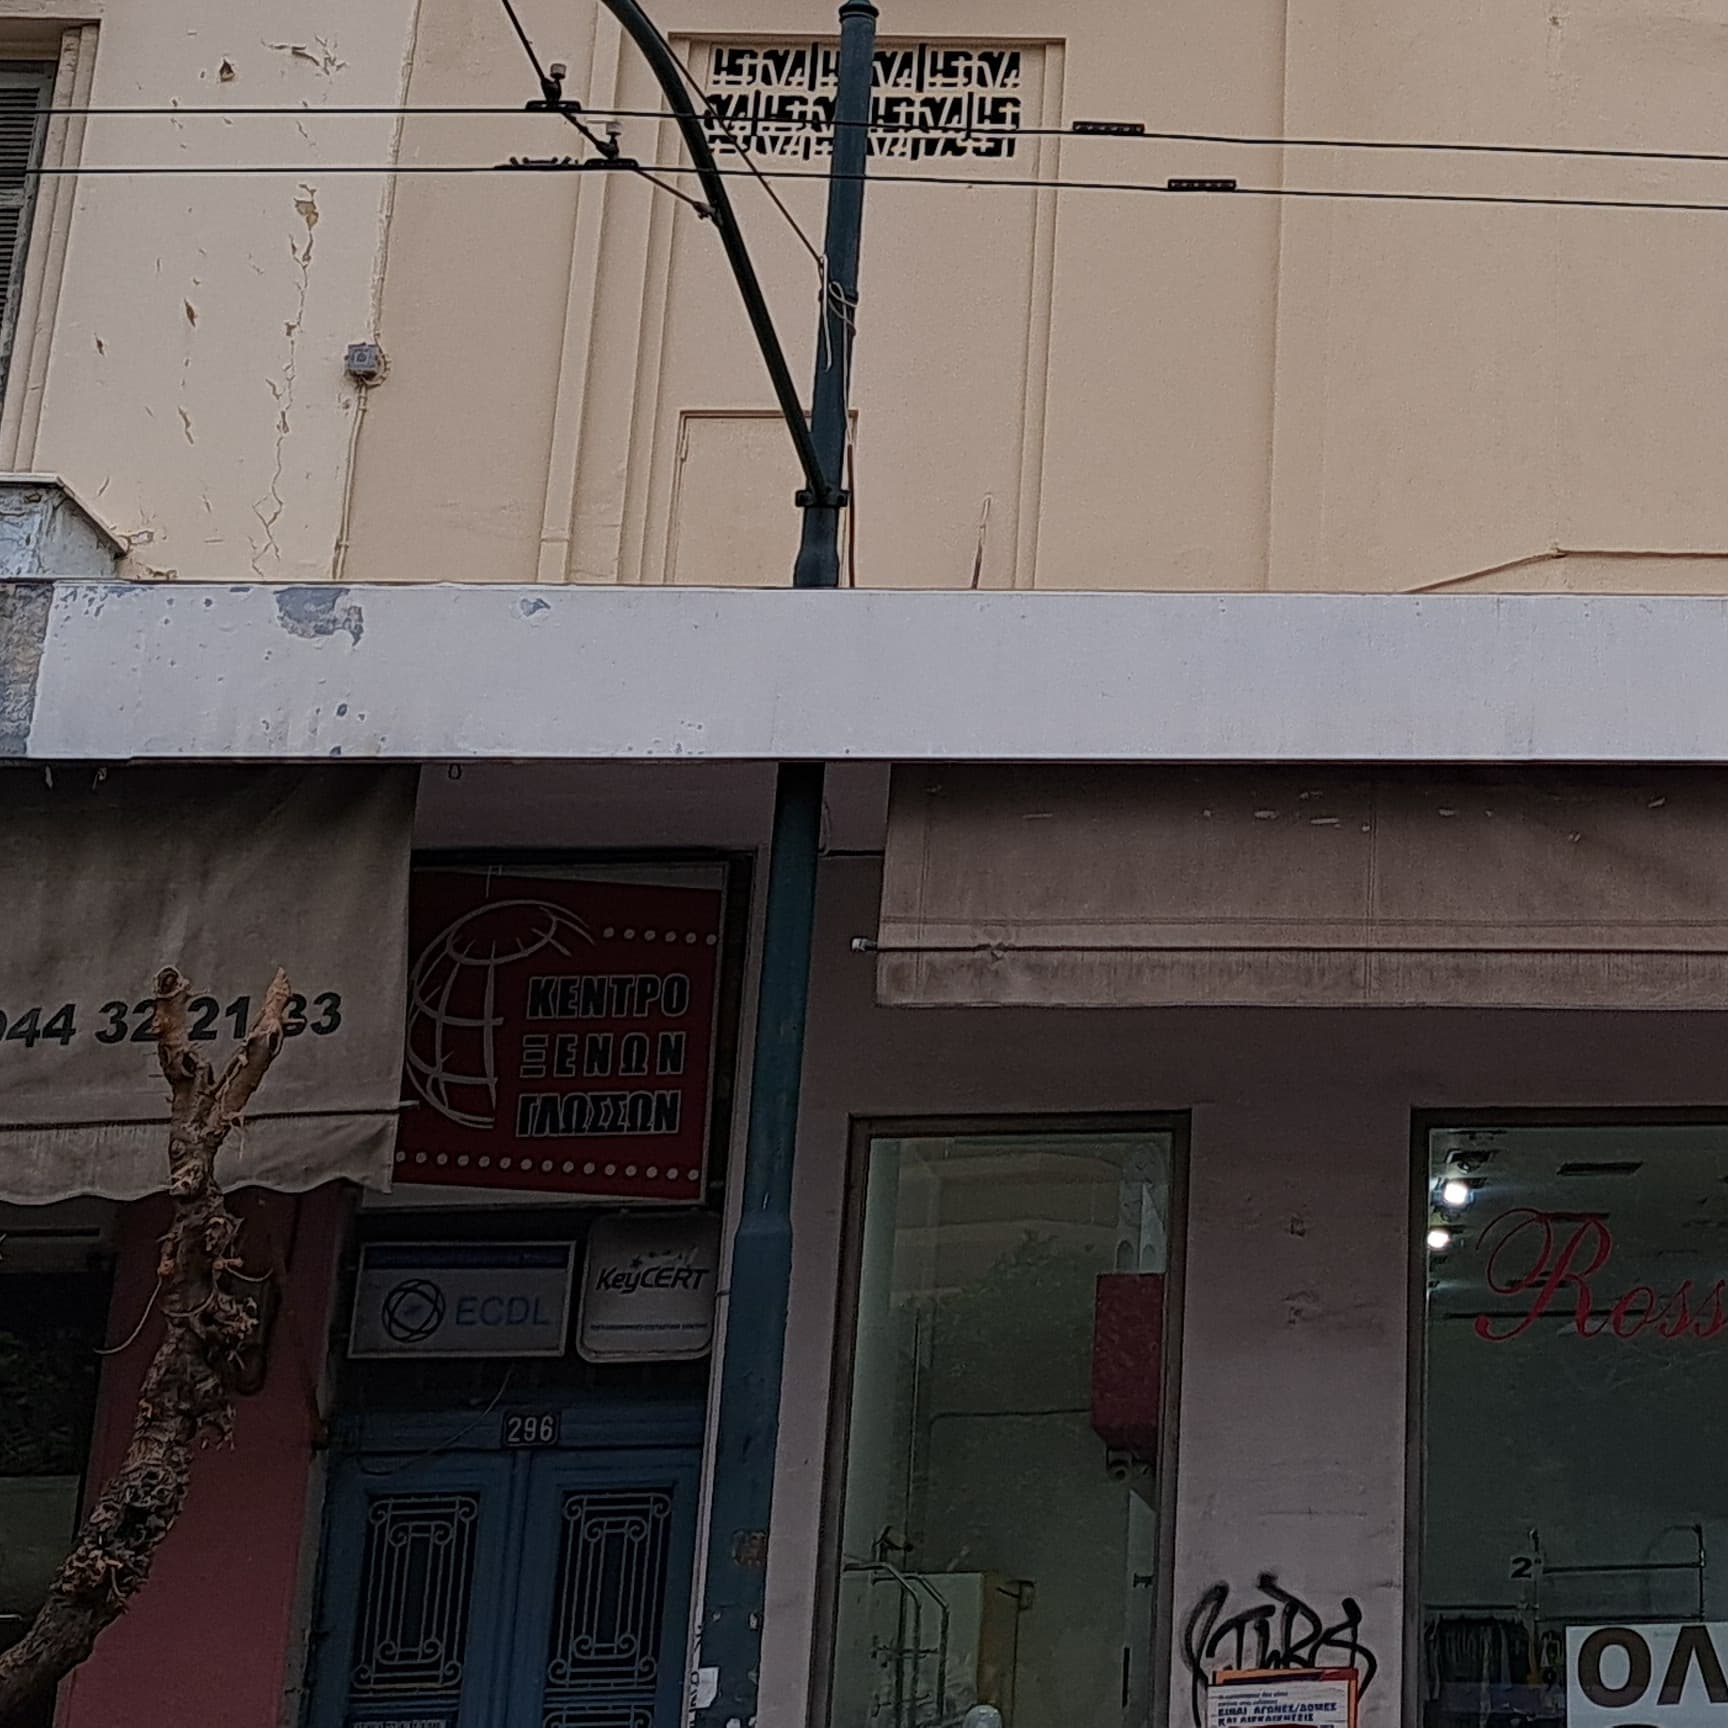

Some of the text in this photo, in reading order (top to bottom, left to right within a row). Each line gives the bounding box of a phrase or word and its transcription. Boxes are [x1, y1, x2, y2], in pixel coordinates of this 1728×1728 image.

[95, 998, 162, 1045] 32
[188, 995, 251, 1041] 21
[281, 991, 343, 1037] 33
[526, 972, 690, 1020] ΚΕΝΤΡΟ
[519, 1030, 688, 1079] ΞΕΝΩΝ
[515, 1089, 682, 1138] ΓΛΩΣΣΩΝ
[595, 1265, 710, 1294] KeyCERT
[455, 1296, 550, 1326] ECDL
[507, 1415, 555, 1444] 296
